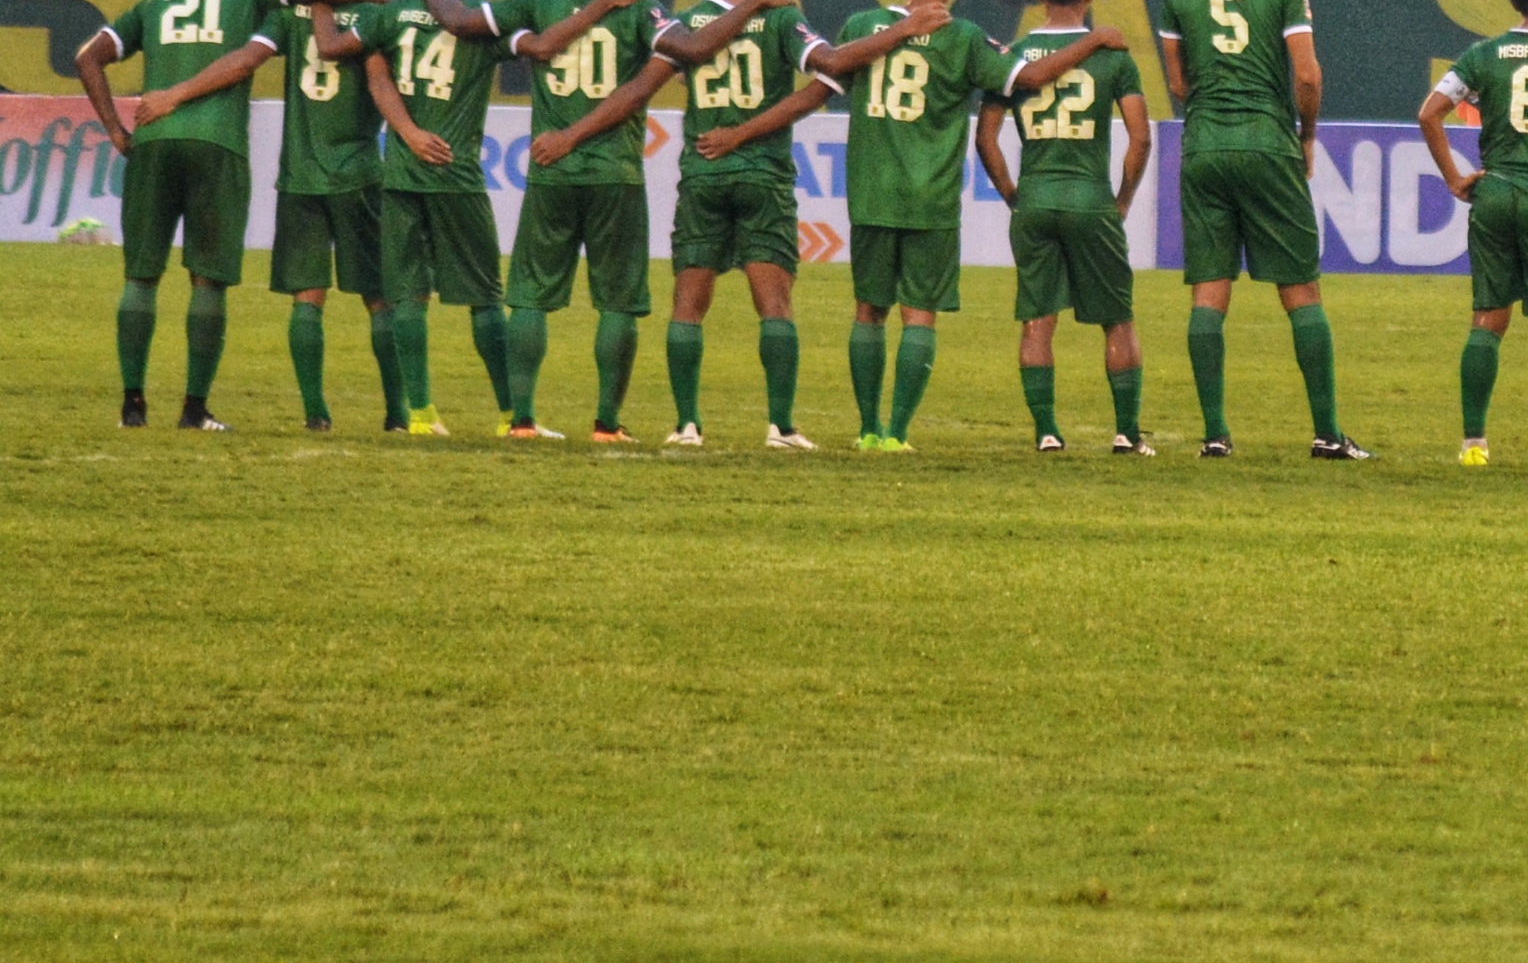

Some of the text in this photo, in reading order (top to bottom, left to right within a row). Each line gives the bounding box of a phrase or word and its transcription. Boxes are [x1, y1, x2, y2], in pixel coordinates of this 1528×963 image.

[300, 33, 340, 102] 8
[397, 26, 457, 102] 14
[694, 39, 765, 110] 20
[867, 50, 929, 122] 18
[1021, 69, 1095, 140] 22
